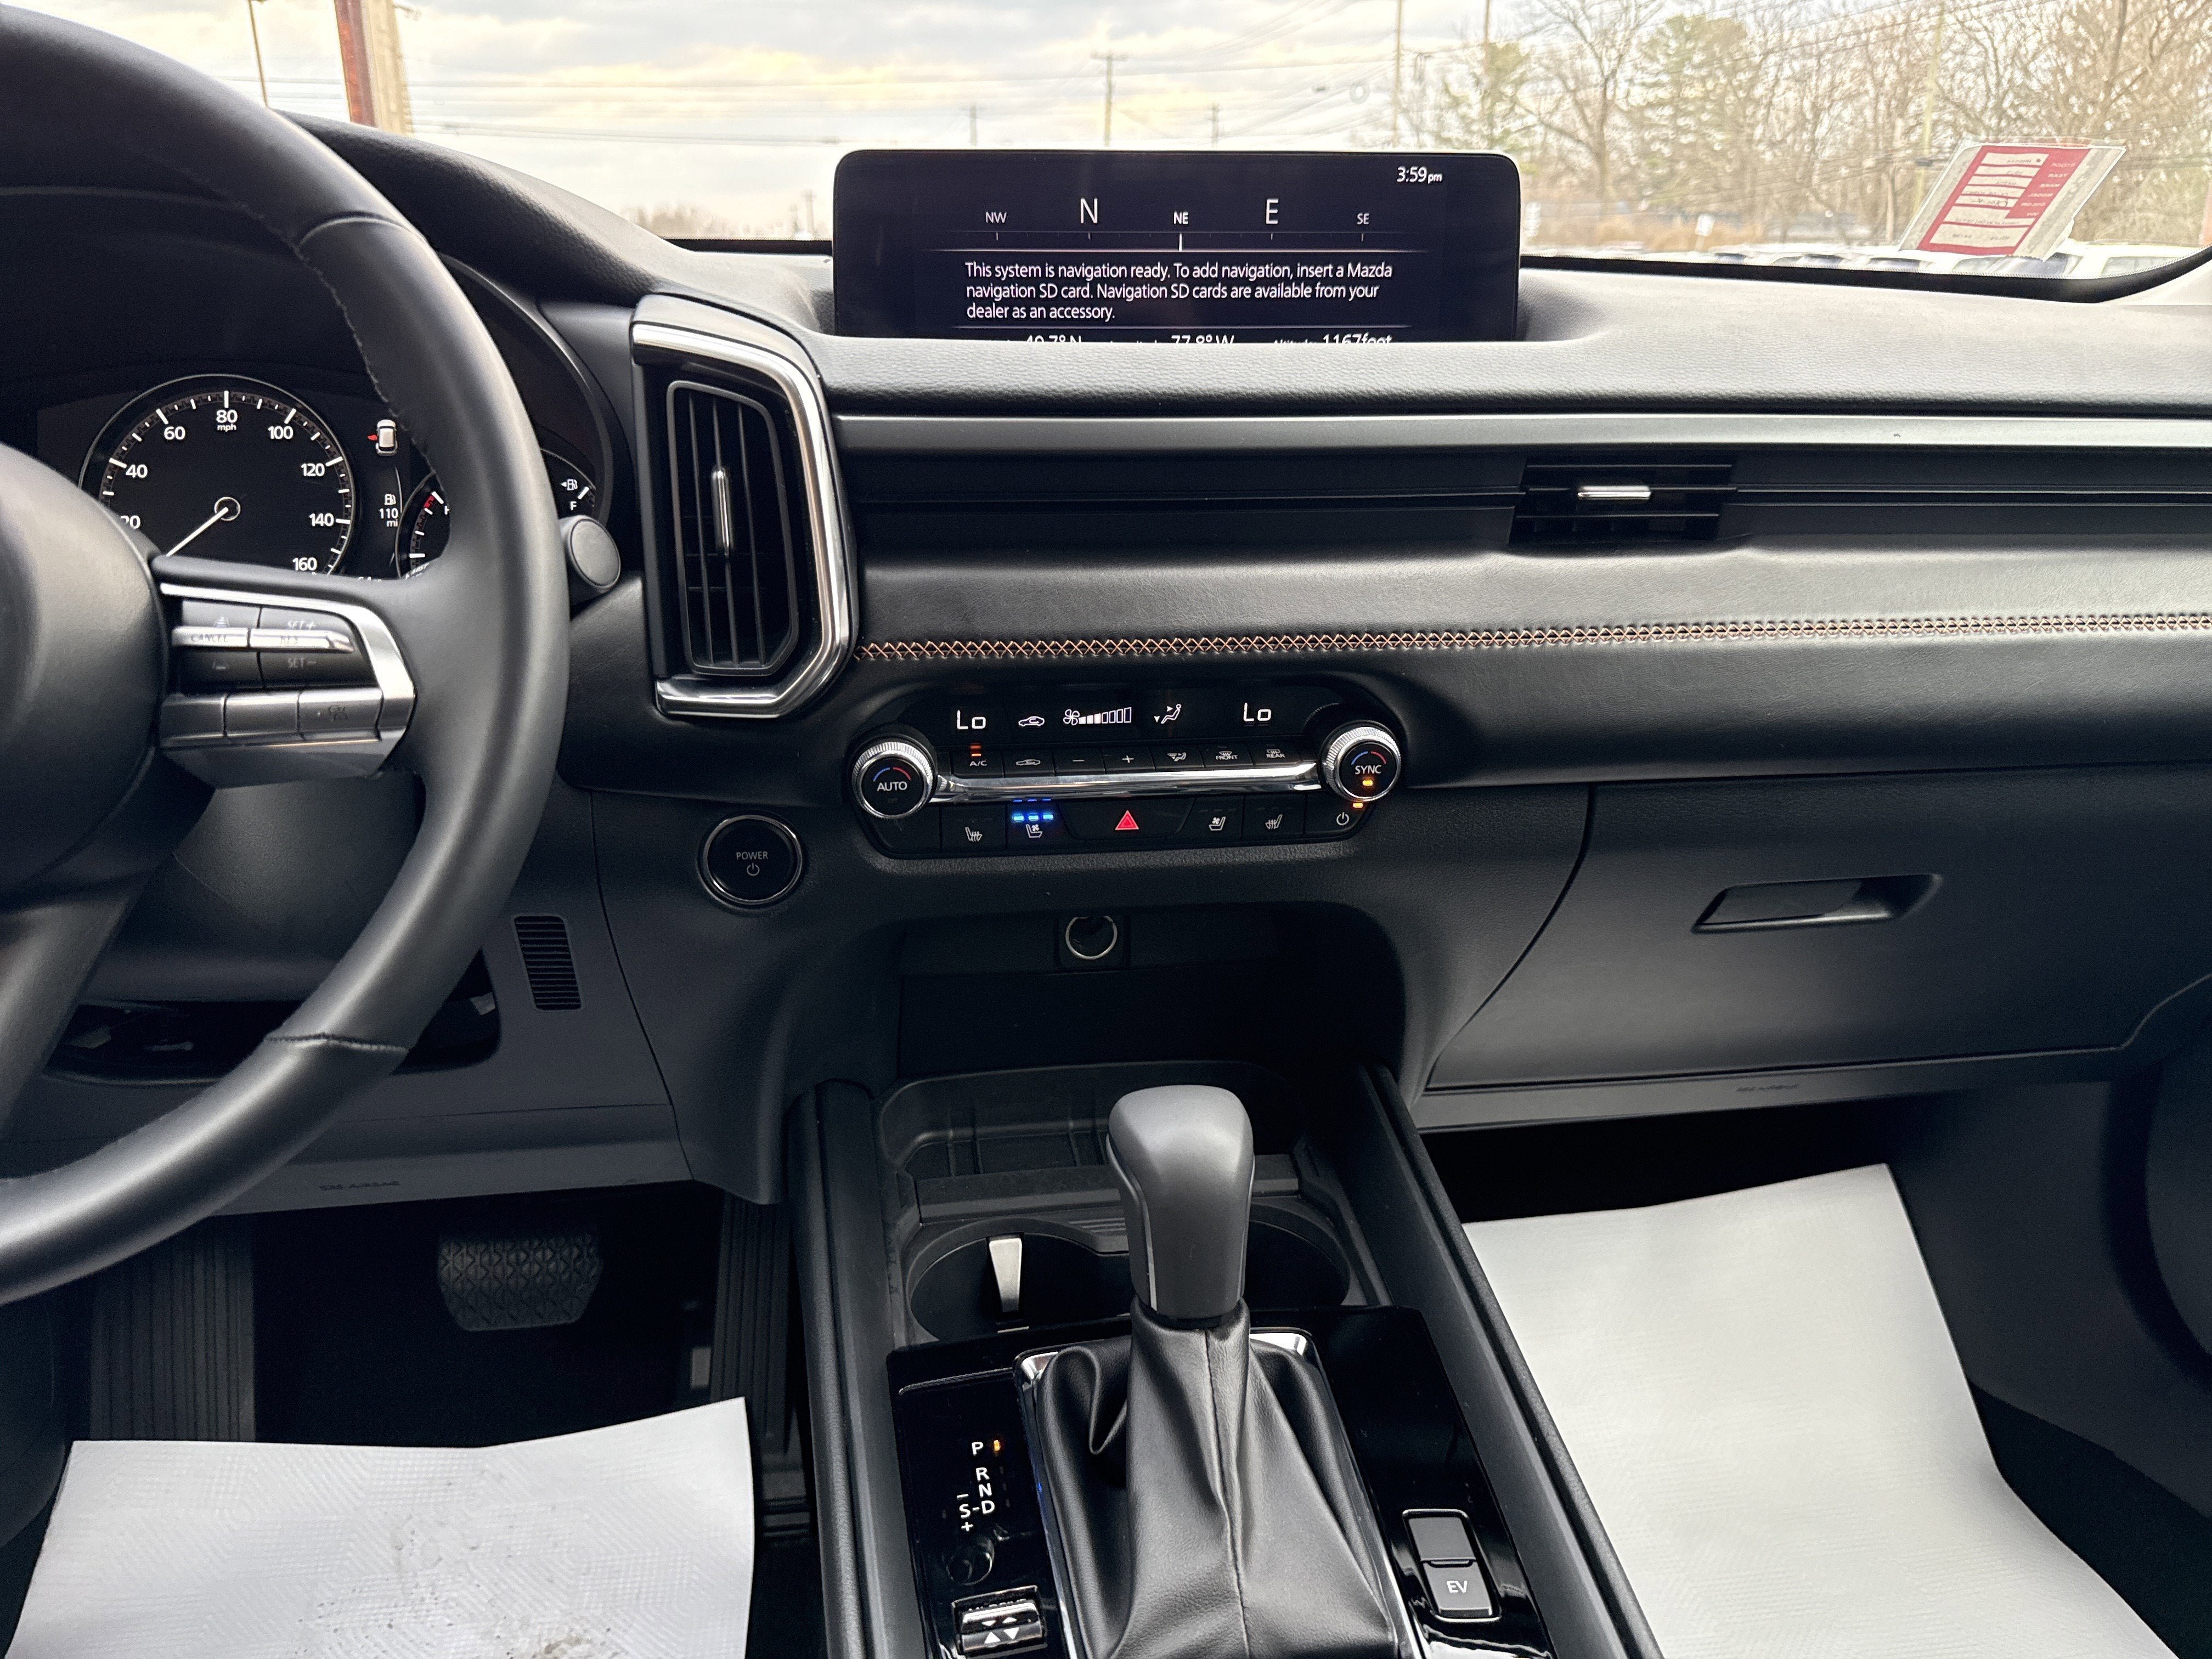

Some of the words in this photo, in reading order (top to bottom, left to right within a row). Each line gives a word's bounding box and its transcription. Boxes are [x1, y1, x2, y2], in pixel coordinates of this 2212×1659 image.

[985, 212, 1007, 223] NW
[1081, 198, 1098, 224] N
[1173, 211, 1189, 224] NE
[1266, 199, 1279, 224] E
[1357, 213, 1369, 225] SE
[965, 261, 992, 278] This
[995, 264, 1041, 281] system
[1045, 263, 1055, 278] is
[1058, 263, 1127, 281] navigation
[1131, 262, 1170, 281] ready.
[1173, 262, 1190, 278] To
[1193, 262, 1218, 278] add
[1222, 263, 1294, 281] navigation,
[1297, 263, 1334, 278] insert
[1336, 266, 1344, 278] a
[1347, 262, 1392, 278] Mazda
[966, 283, 1036, 302] navigation
[1039, 283, 1058, 298] SD
[1061, 283, 1093, 298] card.
[1097, 283, 1167, 302] Navigation
[1171, 283, 1189, 298] SD
[1192, 283, 1228, 298] cards
[1231, 286, 1252, 298] are
[1255, 282, 1312, 298] available
[1315, 281, 1346, 298] from
[1348, 286, 1379, 302] your
[967, 302, 1009, 319] dealer
[1012, 307, 1026, 319] as
[1029, 307, 1046, 319] an
[1049, 307, 1115, 322] accessory.
[216, 409, 238, 424] 80
[163, 426, 185, 440] 60
[217, 424, 237, 432] mph
[268, 426, 294, 440] 100
[126, 464, 148, 478] 40
[301, 462, 325, 477] 120
[379, 507, 399, 519] 110
[570, 501, 577, 511] F
[309, 513, 334, 527] 140
[386, 518, 398, 527] mi
[292, 557, 317, 571] 160
[1243, 702, 1272, 722] Lo
[957, 710, 987, 730] Lo
[1355, 764, 1381, 775] SYNC
[877, 781, 908, 792] AUTO
[736, 851, 769, 860] POWER
[972, 1442, 984, 1455] P
[975, 1467, 990, 1481] R
[978, 1482, 992, 1497] N
[1447, 1580, 1468, 1594] EV
